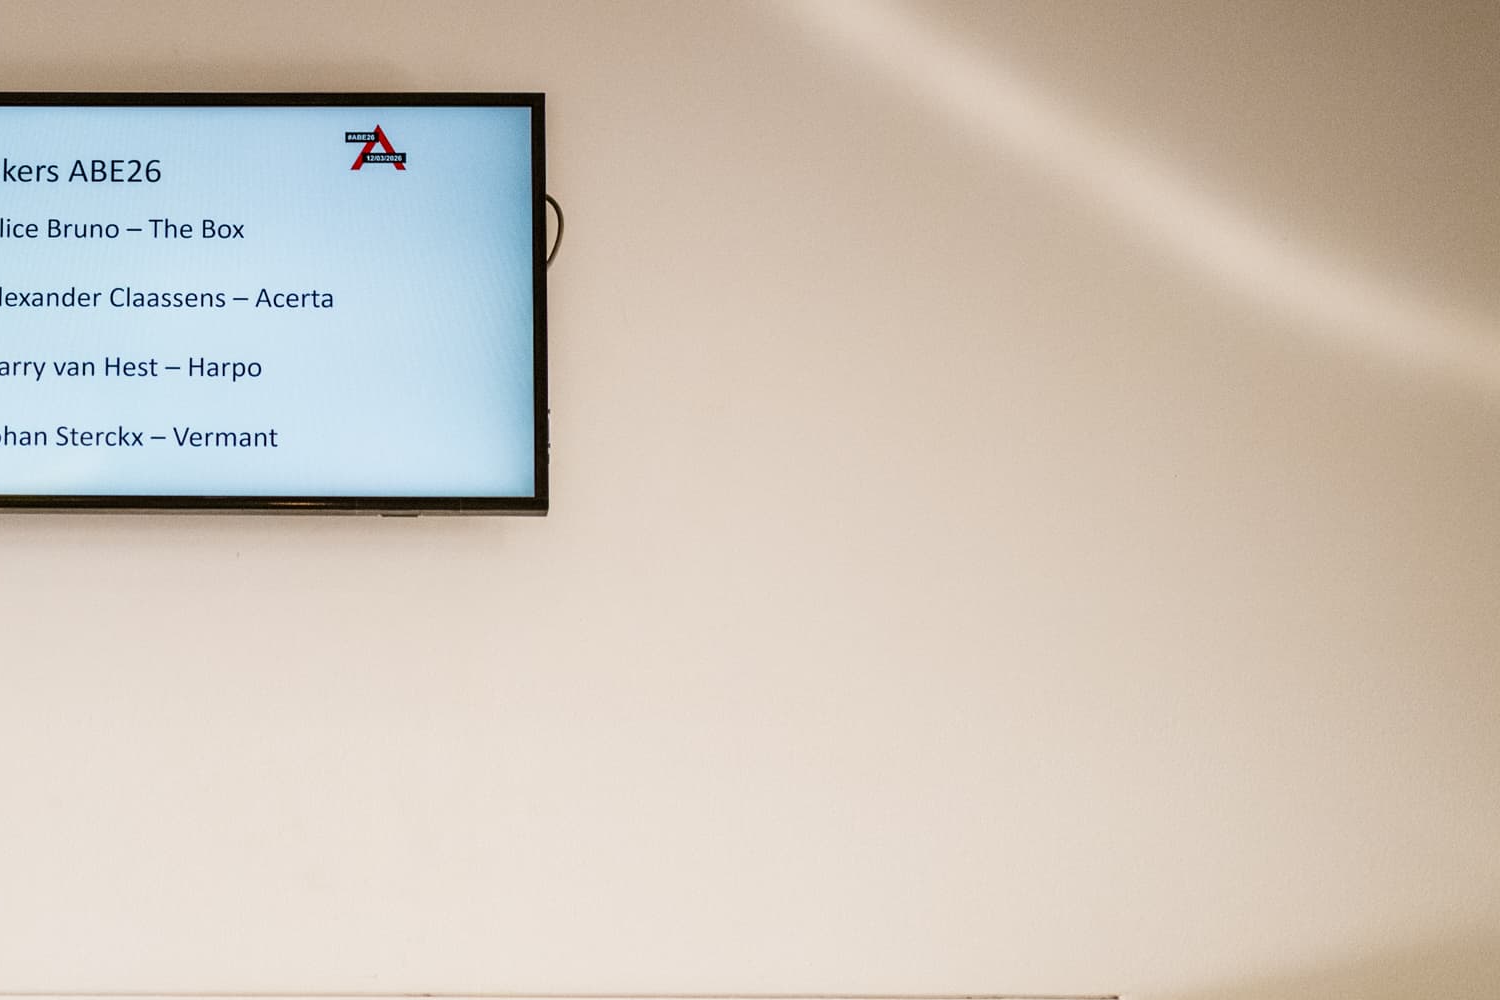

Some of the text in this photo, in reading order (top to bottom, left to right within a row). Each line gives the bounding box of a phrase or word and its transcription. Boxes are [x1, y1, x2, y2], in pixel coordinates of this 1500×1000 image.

[67, 159, 162, 183] ABE26
[47, 218, 120, 239] Bruno
[147, 217, 193, 239] The
[202, 218, 245, 240] Box
[109, 286, 226, 309] Claassens
[254, 287, 334, 309] Acerta
[52, 361, 96, 377] van
[104, 356, 159, 378] Hest
[188, 356, 262, 383] Harpo
[55, 425, 144, 447] Sterckx
[172, 426, 279, 448] Vermant
